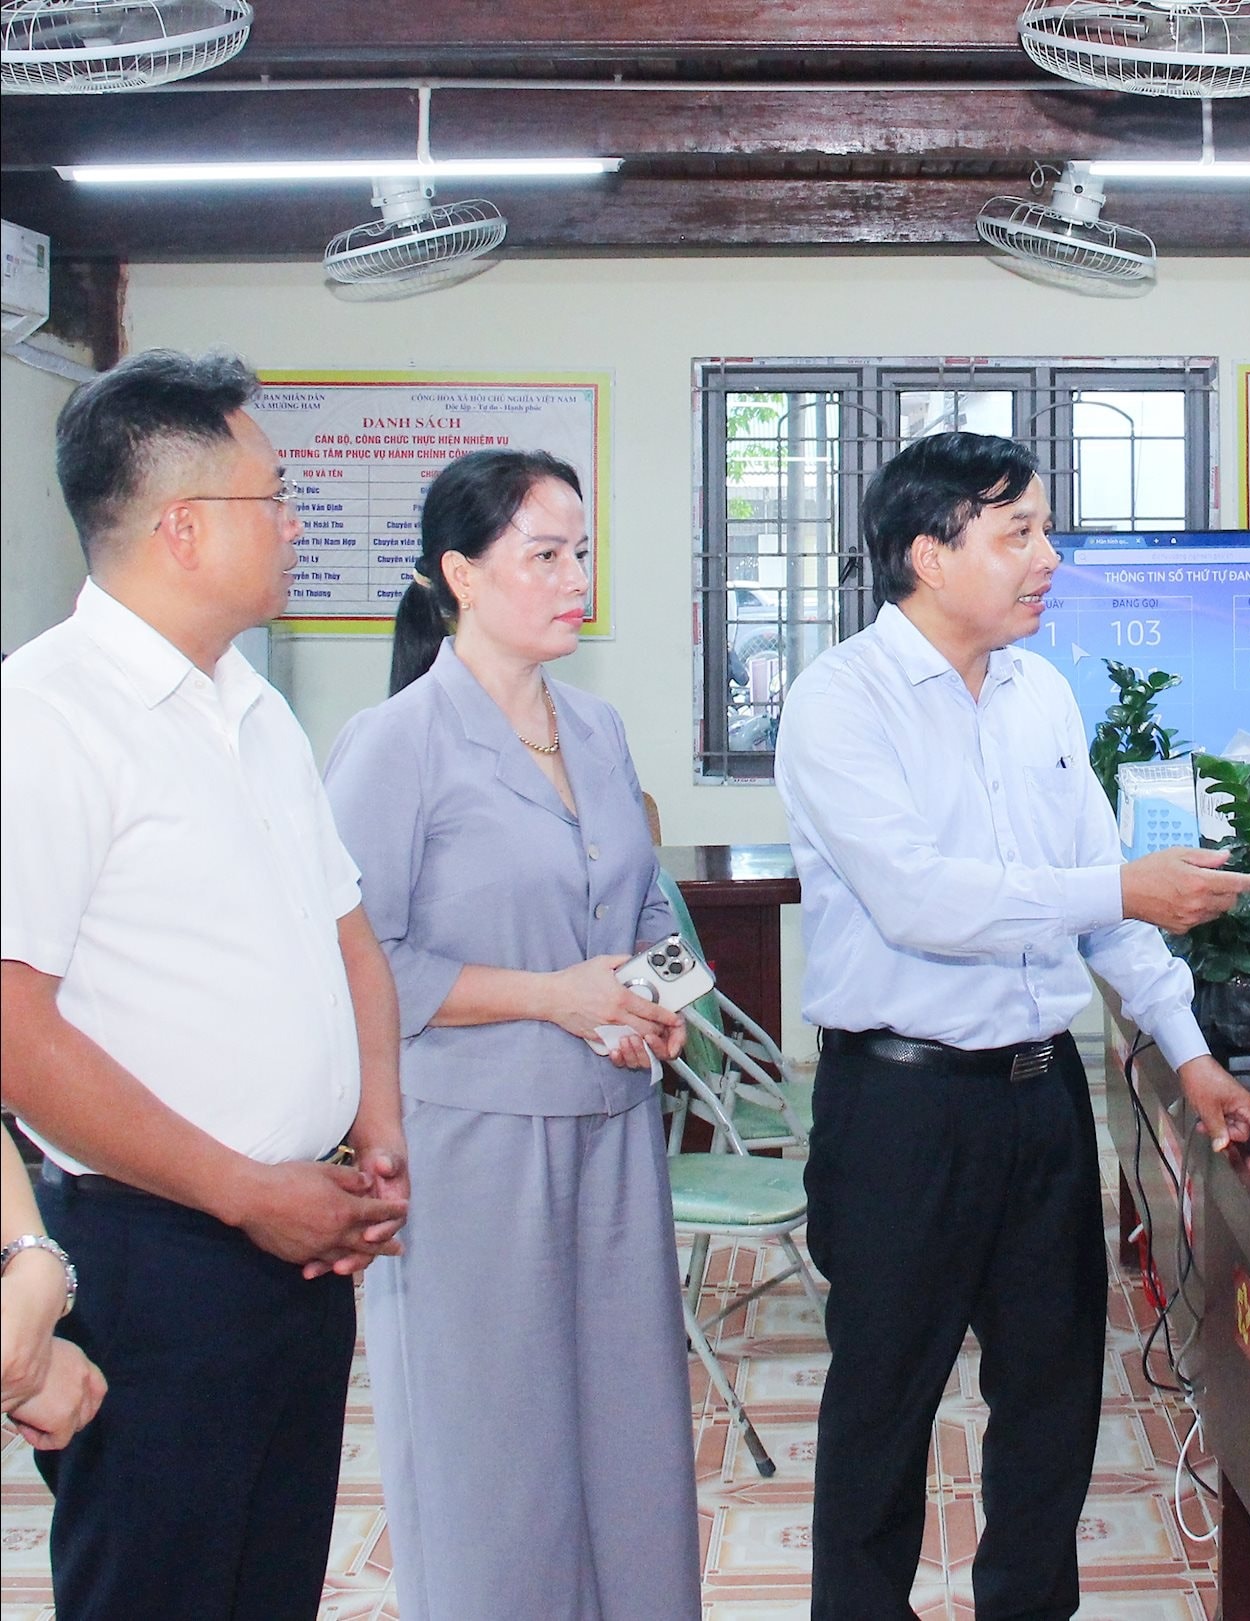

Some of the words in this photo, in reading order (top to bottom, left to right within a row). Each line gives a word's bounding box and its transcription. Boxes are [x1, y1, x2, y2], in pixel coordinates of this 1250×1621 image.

[558, 395, 577, 403] NAM
[363, 417, 410, 428] DANH
[415, 415, 460, 429] SÁCH
[315, 434, 334, 444] CÁN
[355, 434, 381, 444] CÔNG
[384, 434, 409, 445] CHỨC
[412, 435, 437, 446] THỰC
[438, 434, 460, 446] HIỆN
[463, 434, 494, 446] NHIỆM
[497, 436, 509, 446] VỤ
[290, 449, 320, 458] TRUNG
[323, 448, 343, 458] TÂM
[346, 449, 371, 460] PHỤC
[374, 449, 385, 460] VỤ
[388, 448, 414, 459] HÀNH
[417, 448, 446, 459] CHÍNH
[1104, 569, 1145, 583] THÔNG
[1149, 571, 1165, 582] TIN
[1168, 568, 1184, 582] SỐ
[1187, 569, 1210, 582] THỨ
[1212, 570, 1227, 584] TỰ
[1112, 599, 1140, 608] ĐANG
[1141, 599, 1159, 609] GỌI
[1045, 621, 1056, 647] 1
[1110, 620, 1161, 646] 103
